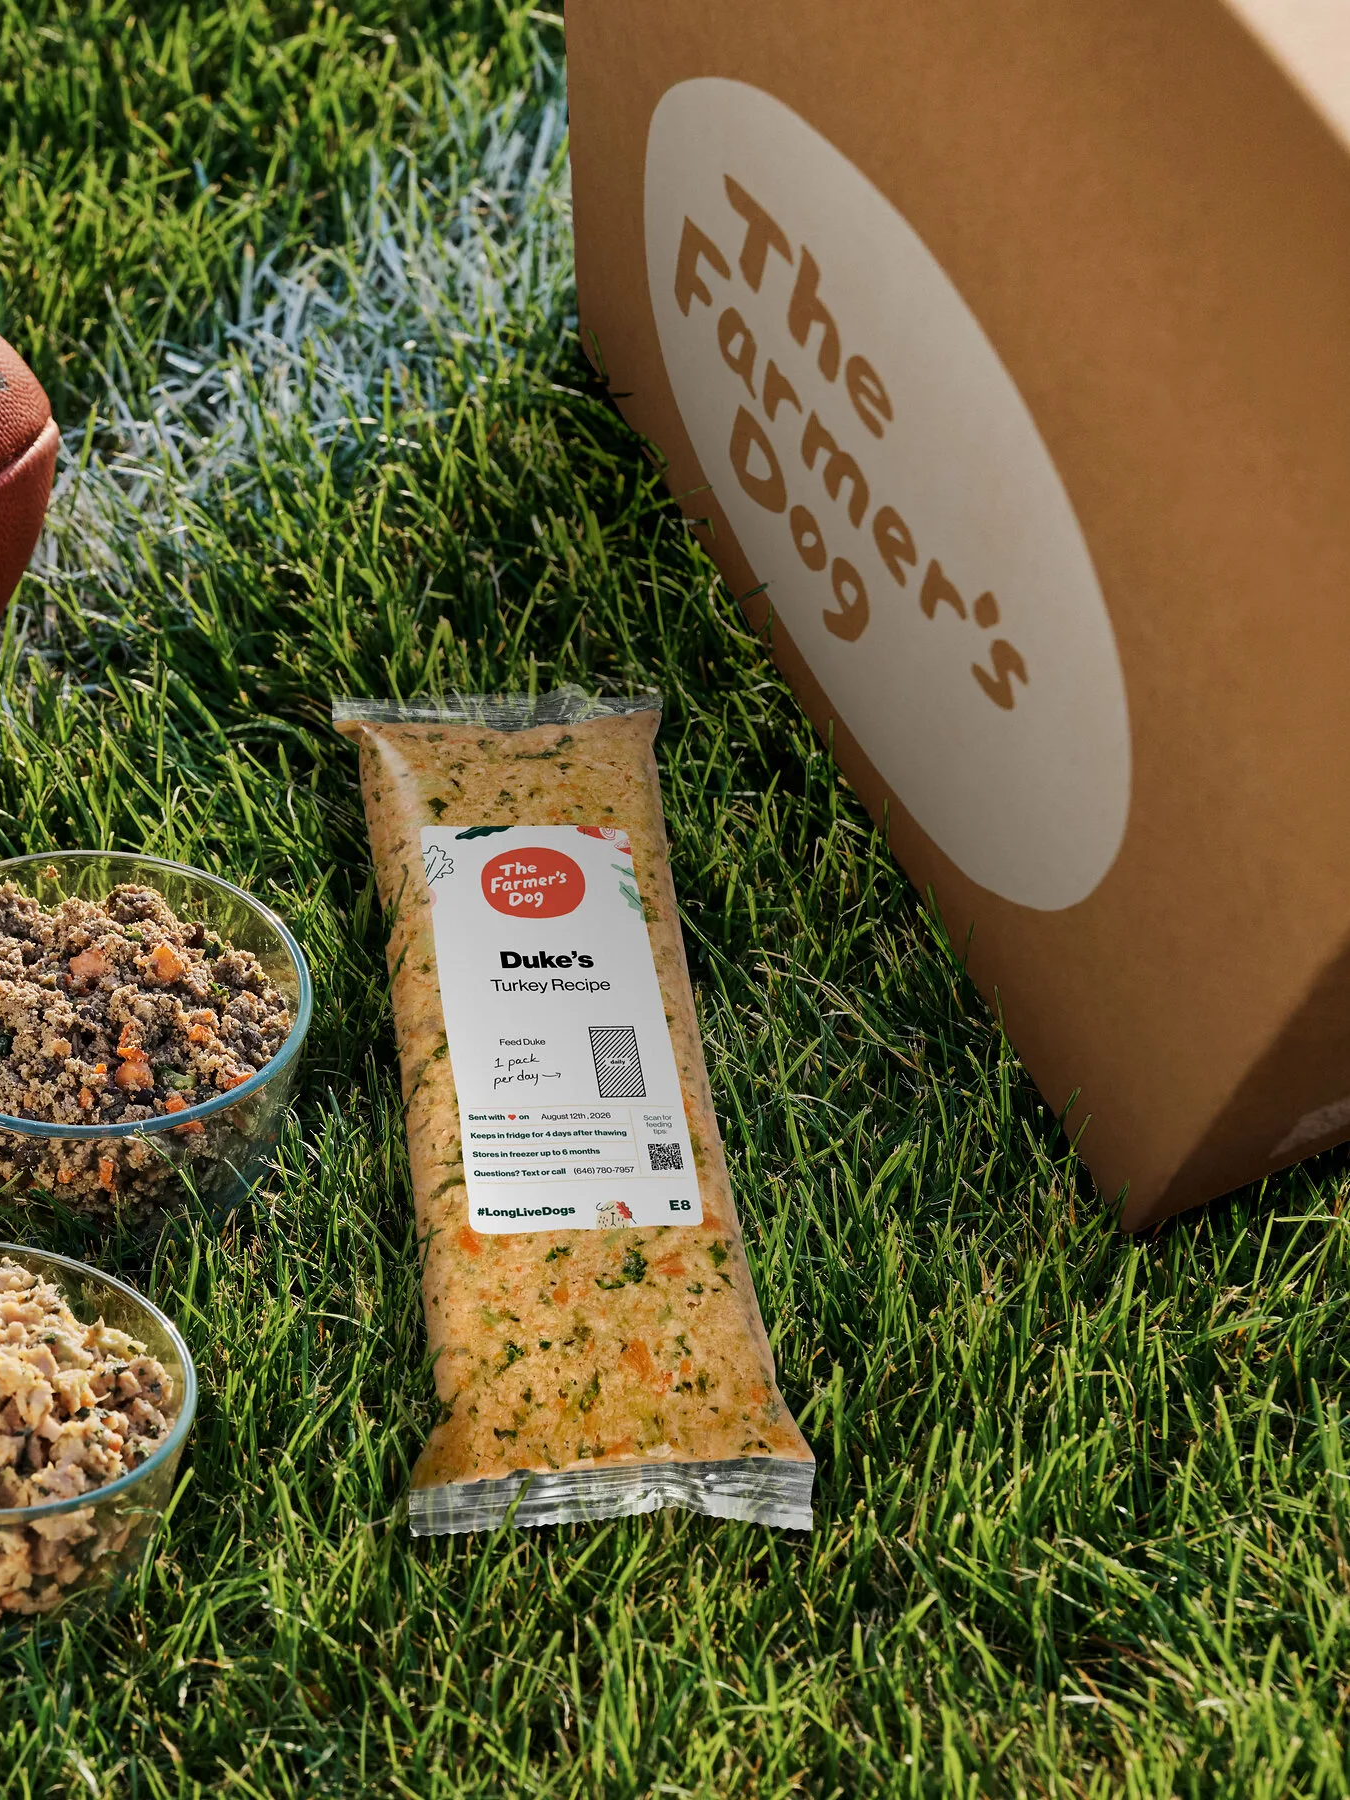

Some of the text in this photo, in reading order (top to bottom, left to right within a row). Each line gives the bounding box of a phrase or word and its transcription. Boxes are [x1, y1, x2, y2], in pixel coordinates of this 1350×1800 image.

[723, 173, 894, 439] The
[674, 215, 1029, 711] Farmer's
[729, 403, 870, 643] Dog
[499, 862, 537, 877] The
[490, 870, 567, 894] Farmer's
[508, 891, 544, 908] Dog
[500, 950, 594, 969] Duke's
[490, 978, 611, 994] Turkey Recipe
[499, 1038, 546, 1046] Feed Duke
[494, 1053, 540, 1071] 1 pack
[493, 1069, 539, 1089] per day
[541, 1113, 569, 1121] August
[470, 1132, 496, 1140] Keeps
[506, 1131, 530, 1140] fridge
[552, 1130, 572, 1138] days
[593, 1129, 628, 1138] thawing
[509, 1150, 539, 1158] freezer
[540, 1151, 551, 1159] up
[474, 1169, 520, 1178] Questions?
[573, 1166, 596, 1175] (646)
[596, 1166, 635, 1175] 780-7957
[477, 1206, 576, 1218] #LongLiveDogs
[669, 1200, 692, 1211] E8
